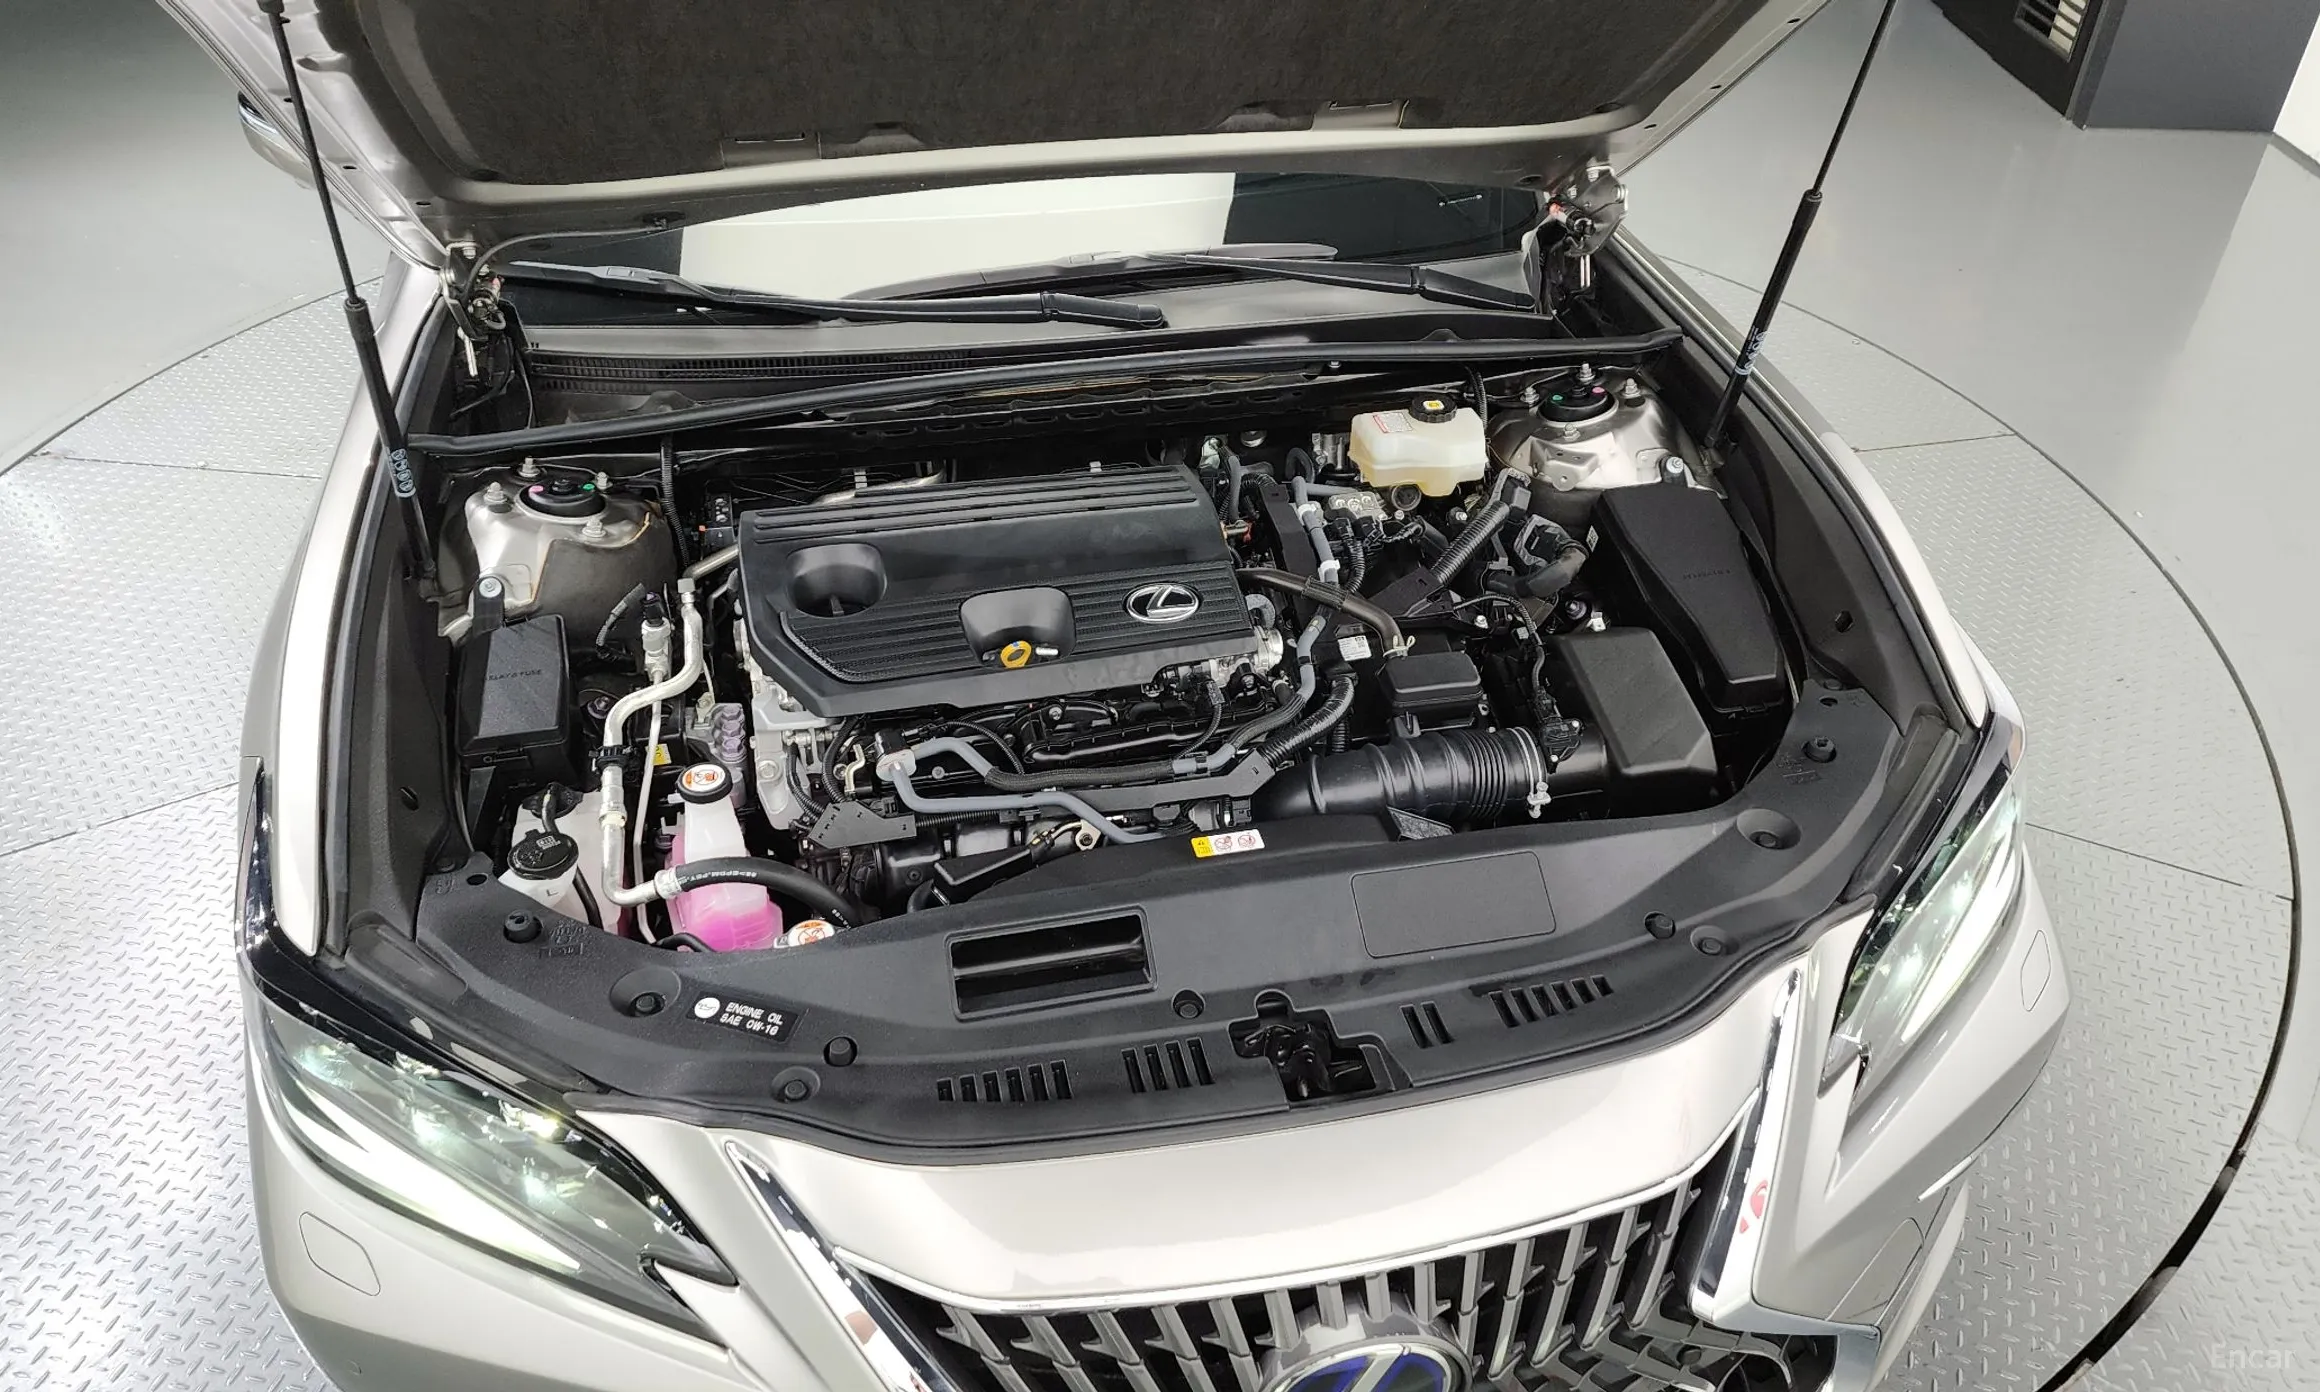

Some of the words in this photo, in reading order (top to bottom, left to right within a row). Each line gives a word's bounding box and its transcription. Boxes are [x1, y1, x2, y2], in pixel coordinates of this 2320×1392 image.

[720, 1013, 743, 1026] SAE
[725, 1002, 765, 1020] ENGINE
[767, 1012, 783, 1026] OIL
